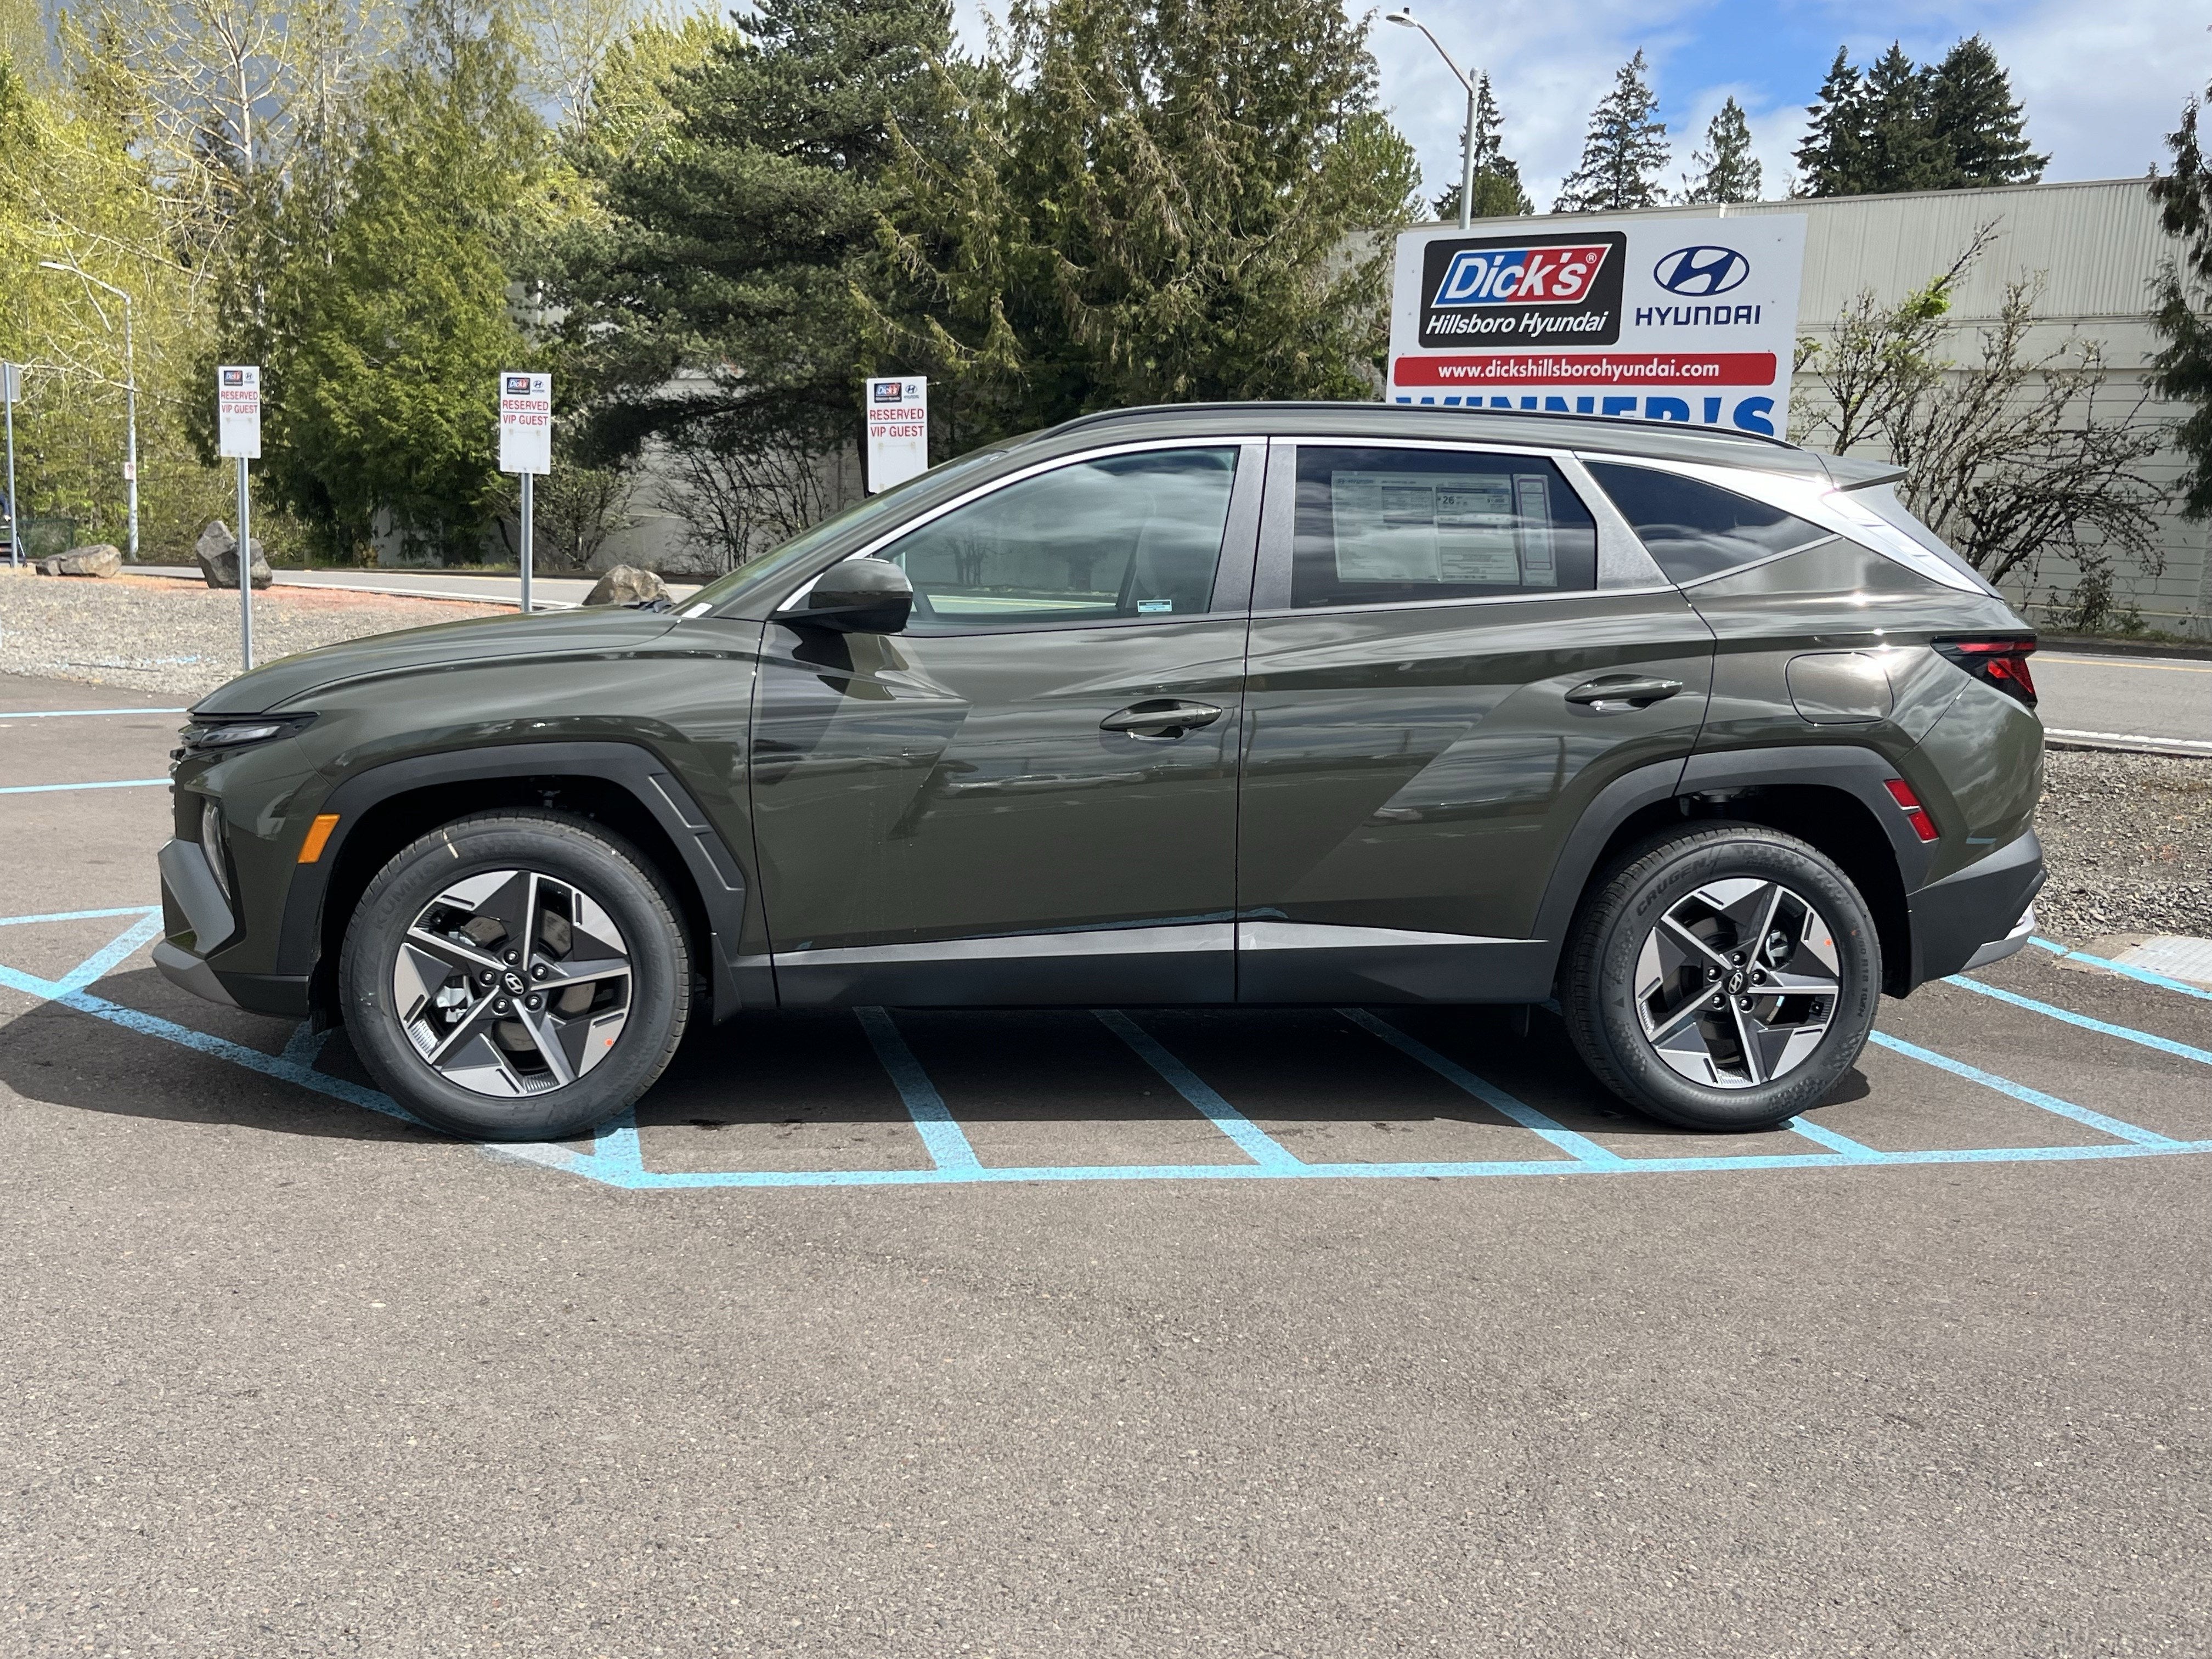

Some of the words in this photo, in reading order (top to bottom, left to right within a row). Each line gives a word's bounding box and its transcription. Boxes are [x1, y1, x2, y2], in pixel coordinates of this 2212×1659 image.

[1635, 305, 1761, 326] HYUNDAI
[1426, 314, 1516, 335] Hillsboro
[1518, 311, 1609, 337] Hyundai
[1438, 358, 1719, 381] www.dickshillsborohyundai.com
[221, 391, 258, 400] RESERVED
[222, 404, 233, 413] VIP
[234, 404, 258, 414] GUEST
[503, 400, 549, 410] RESERVED
[503, 414, 516, 424] VIP
[519, 415, 549, 425] GUEST
[870, 408, 924, 420] RESERVED
[870, 426, 886, 437] VIP
[889, 426, 924, 437] GUEST
[1443, 495, 1454, 504] 26
